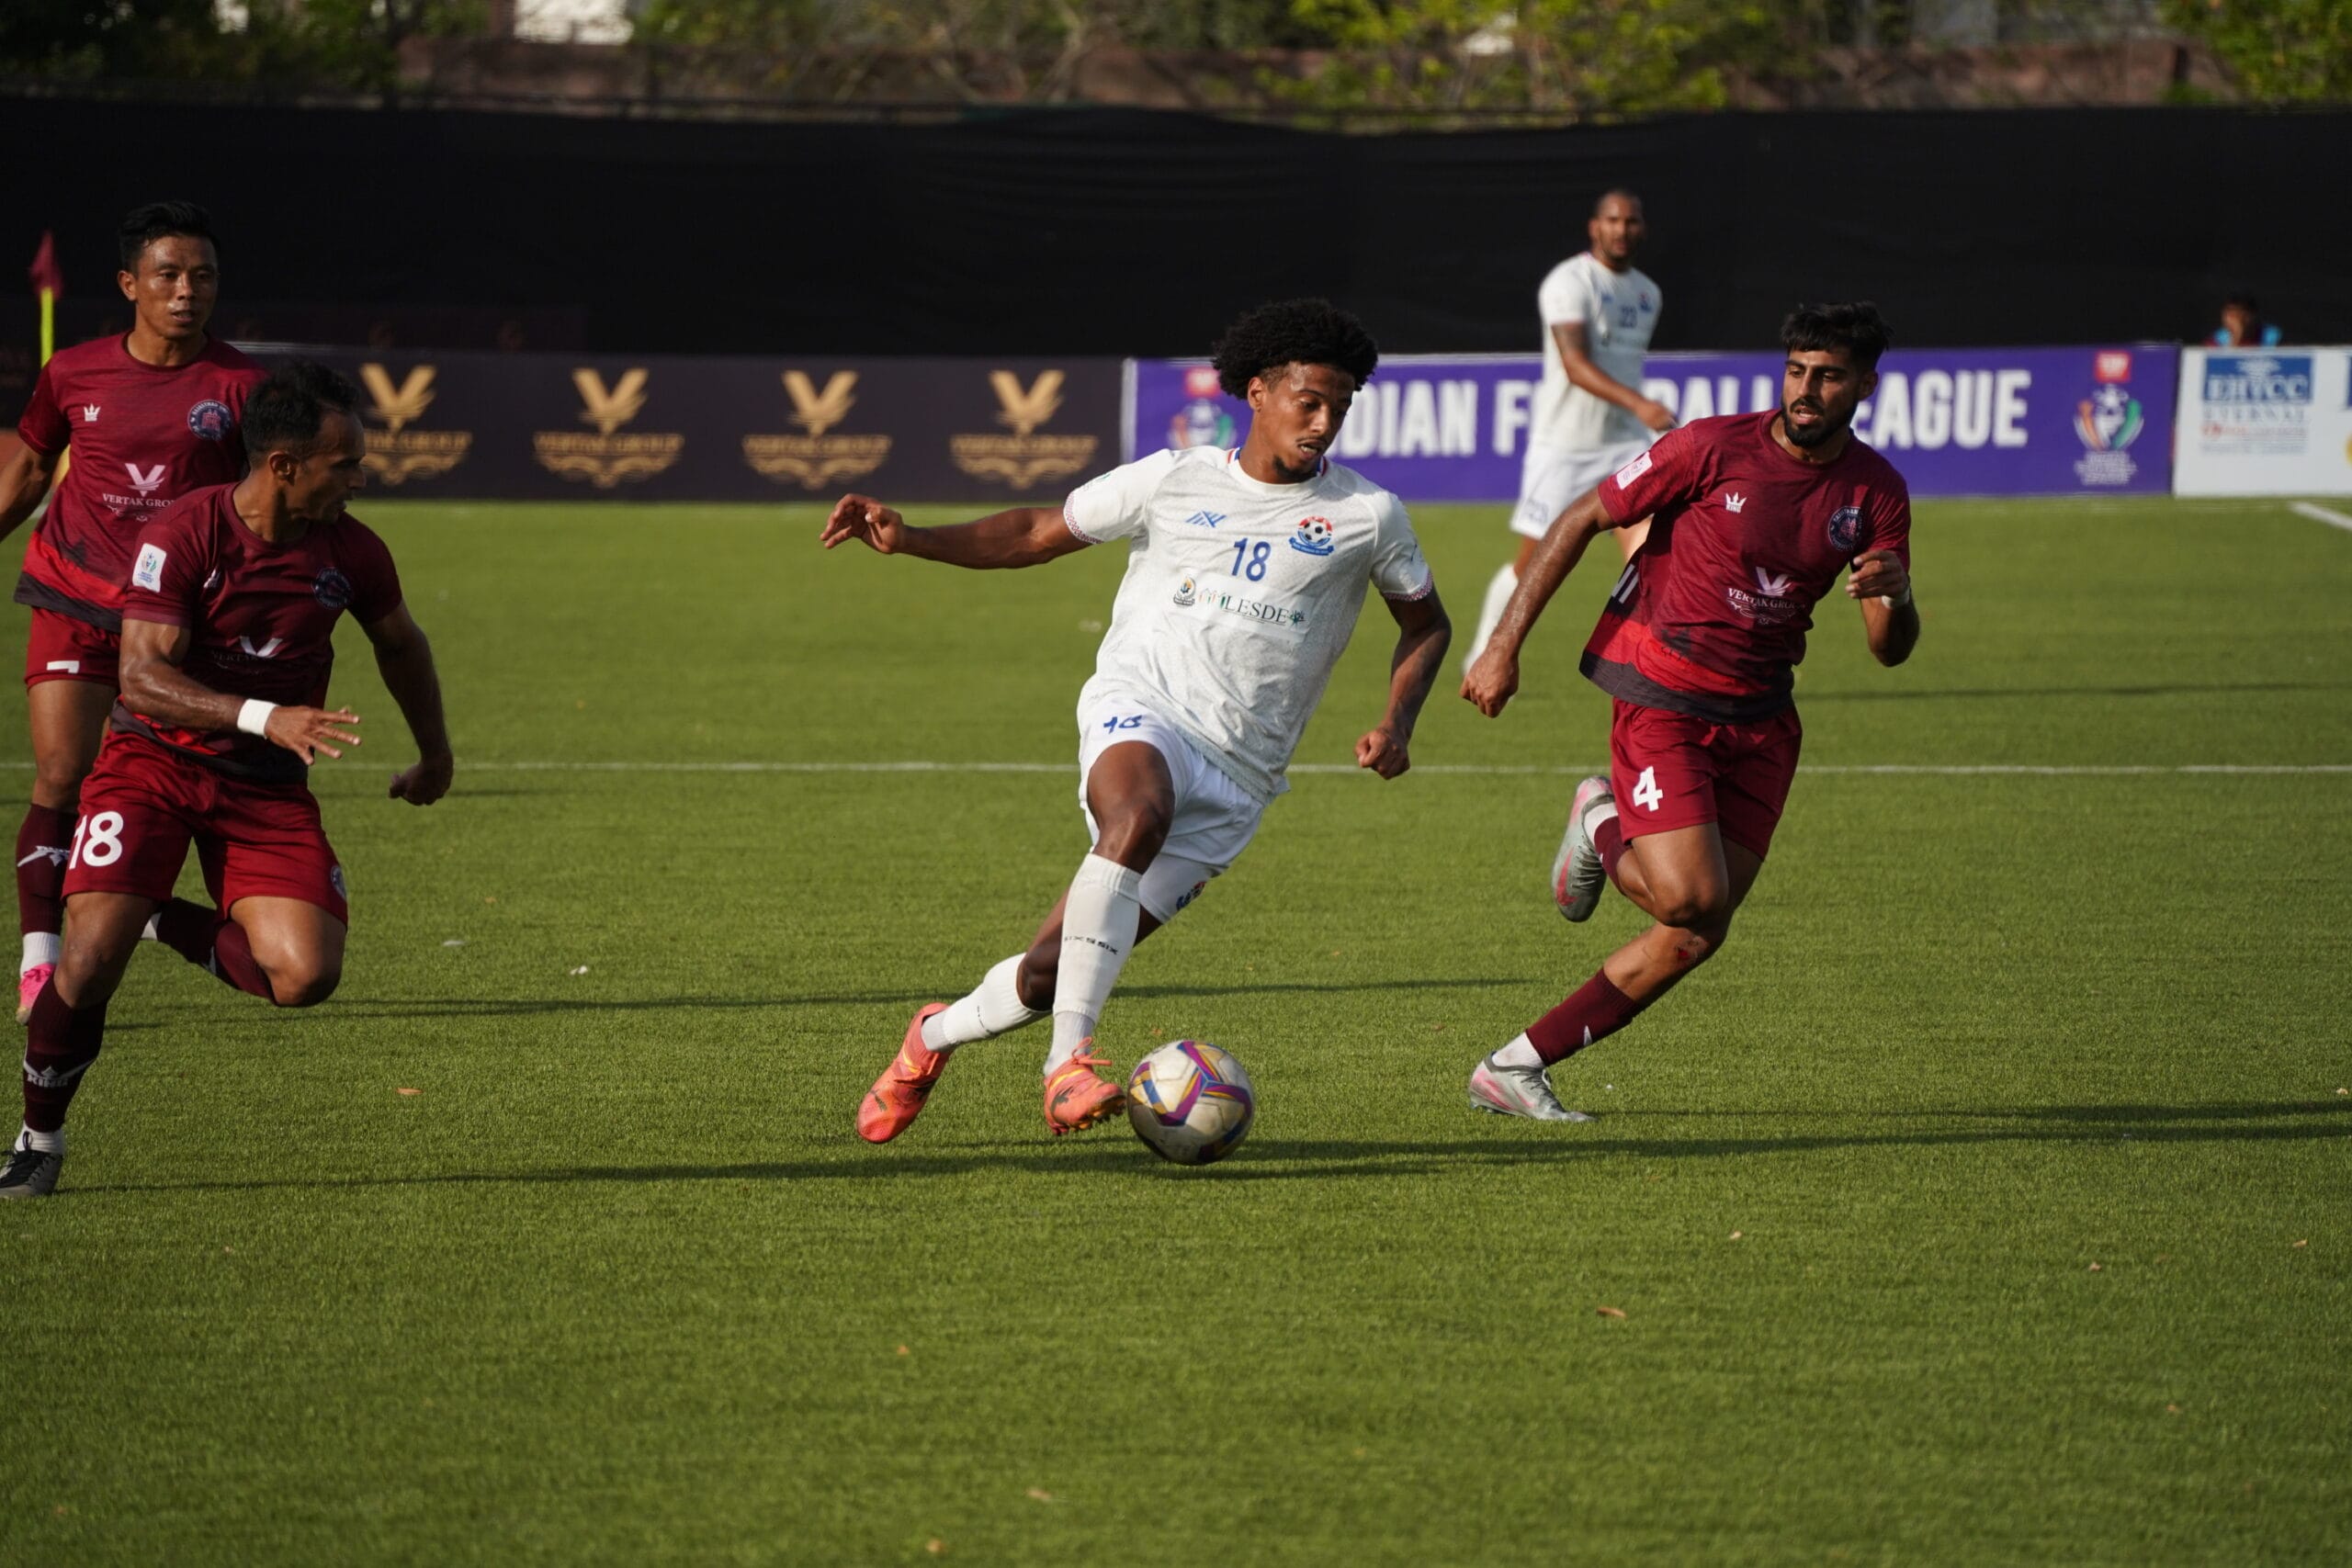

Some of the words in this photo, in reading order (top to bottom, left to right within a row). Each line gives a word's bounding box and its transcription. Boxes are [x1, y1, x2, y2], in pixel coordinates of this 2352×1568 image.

[1328, 378, 1479, 457] DIAN
[1849, 369, 2031, 449] AGUE
[103, 493, 144, 506] VERTAK
[1231, 537, 1272, 581] 18
[1634, 765, 1664, 812] 4
[69, 811, 124, 870] 18
